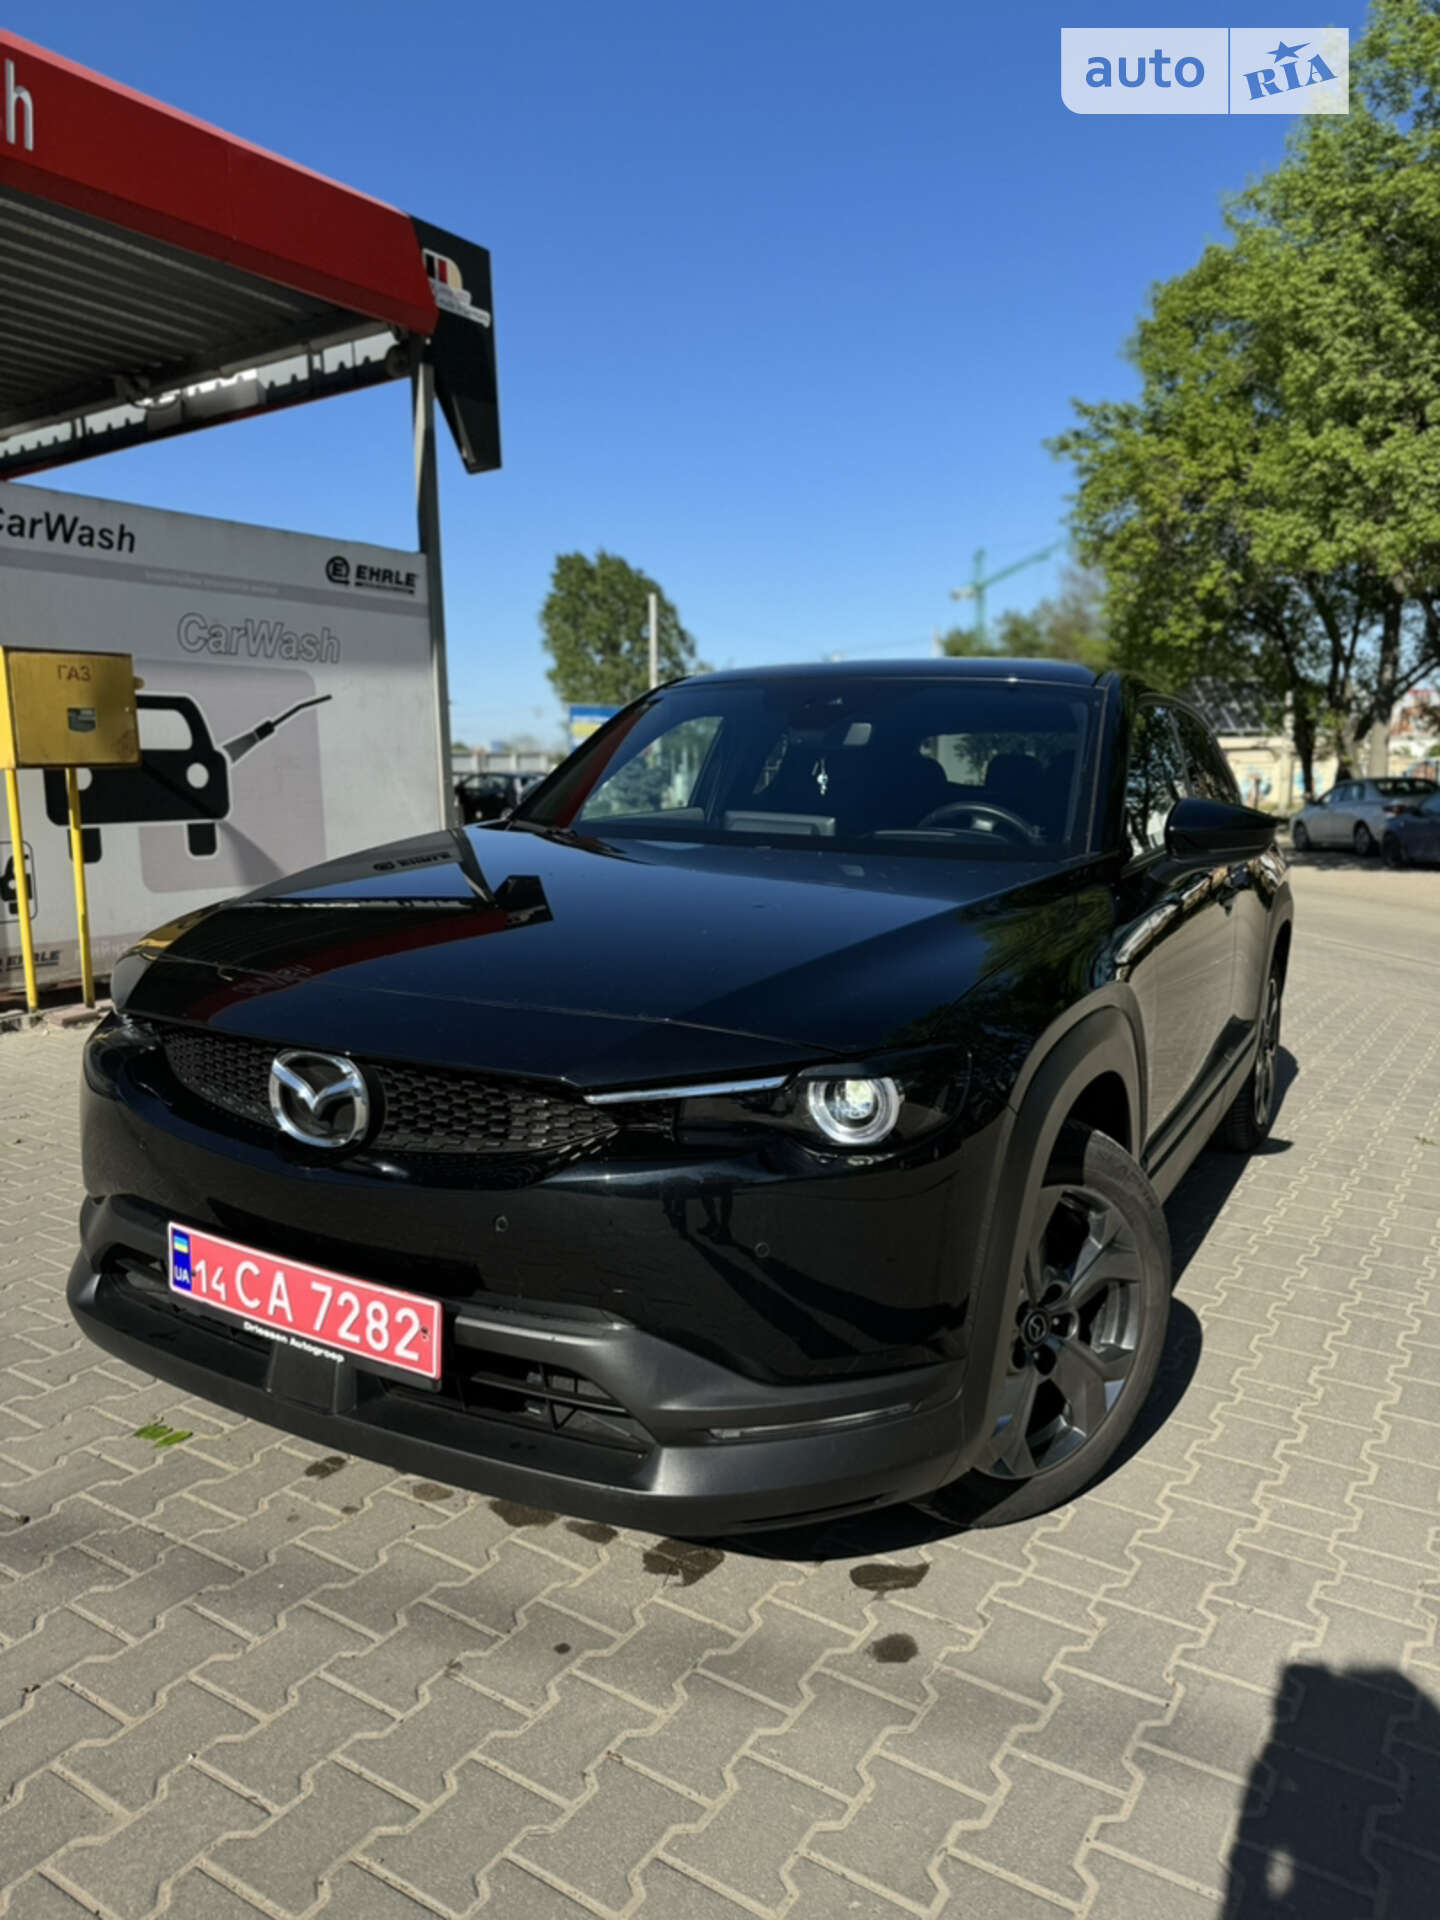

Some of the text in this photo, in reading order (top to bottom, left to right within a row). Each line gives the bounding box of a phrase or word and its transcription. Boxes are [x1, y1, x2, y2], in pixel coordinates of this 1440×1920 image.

[0, 506, 136, 553] arWash
[355, 564, 417, 588] EHRLE
[177, 612, 341, 664] CarWash
[56, 664, 91, 682] ГАЗ
[174, 1265, 190, 1284] UA
[310, 1280, 421, 1362] 7282
